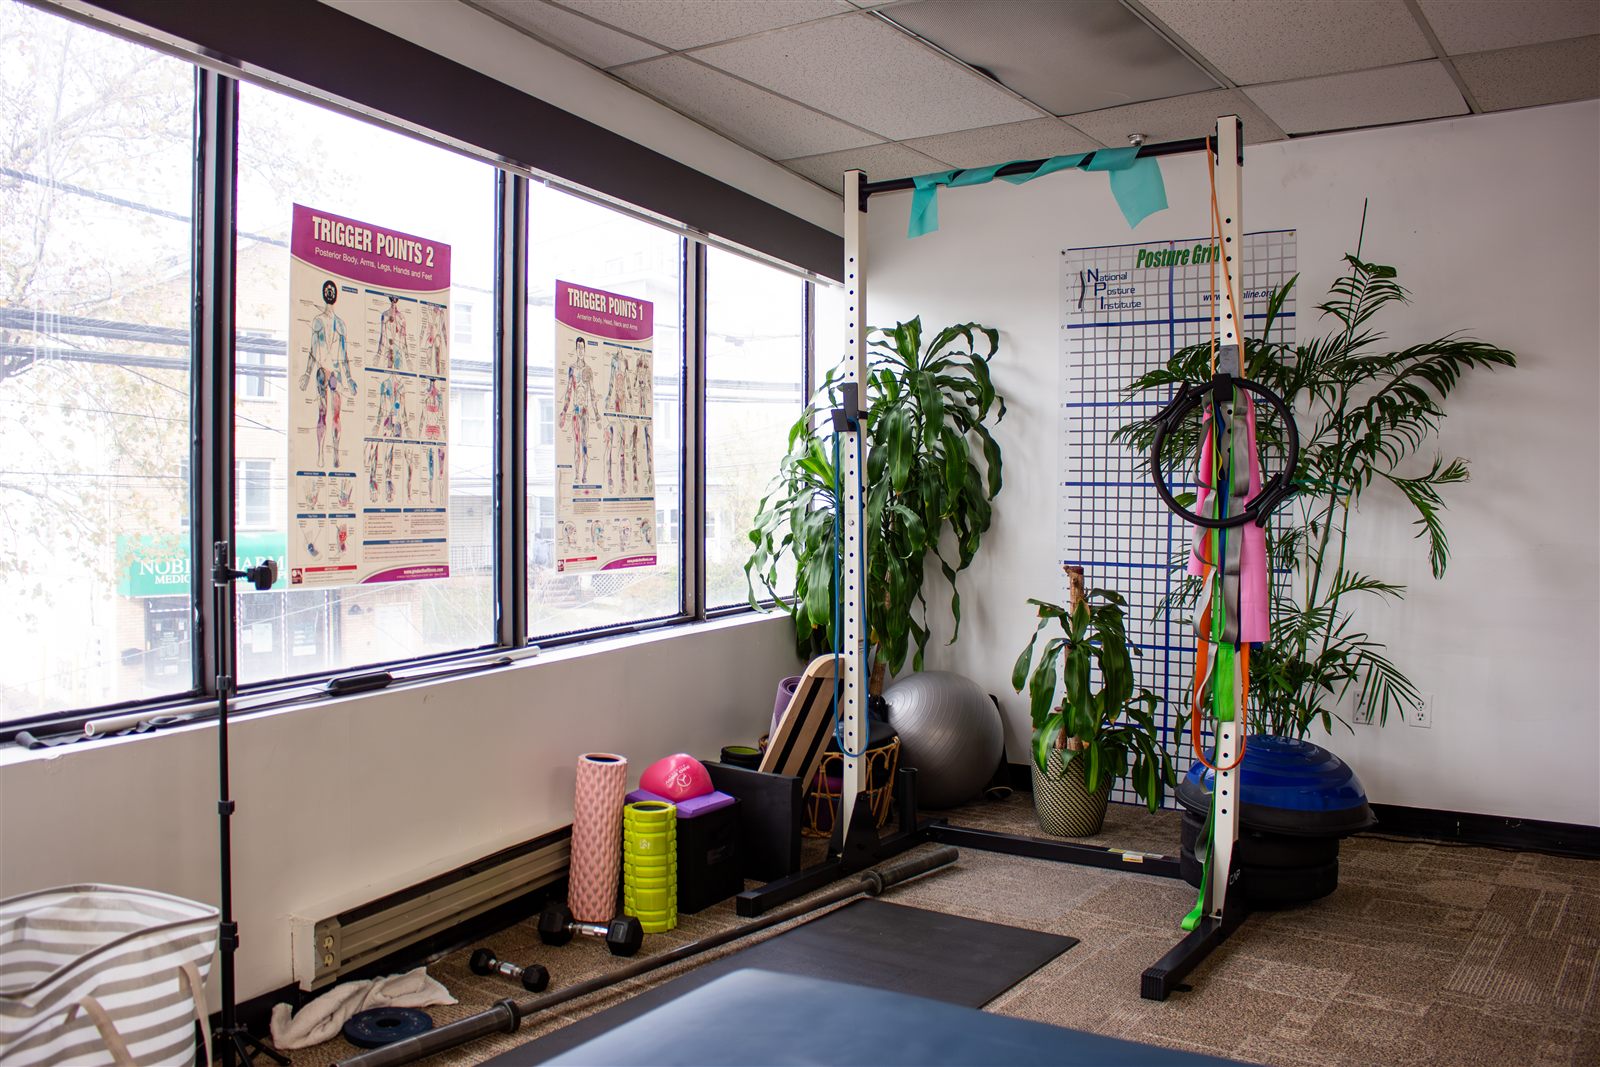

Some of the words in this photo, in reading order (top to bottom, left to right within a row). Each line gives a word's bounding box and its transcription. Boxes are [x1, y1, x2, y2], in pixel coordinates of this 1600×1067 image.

[312, 215, 373, 252] TRIGGER
[376, 232, 423, 265] POINTS
[425, 246, 434, 267] 2
[314, 246, 341, 260] Posterior
[393, 265, 411, 276] Hands
[411, 269, 421, 278] and
[421, 271, 433, 281] Feet
[1136, 248, 1190, 268] Posture
[1087, 268, 1127, 283] National
[1094, 282, 1135, 296] Posture
[567, 287, 607, 313] TRIGGER
[609, 296, 637, 320] POINTS
[639, 304, 643, 321] 1
[1101, 296, 1141, 310] Institute
[154, 574, 191, 584] MEDIC
